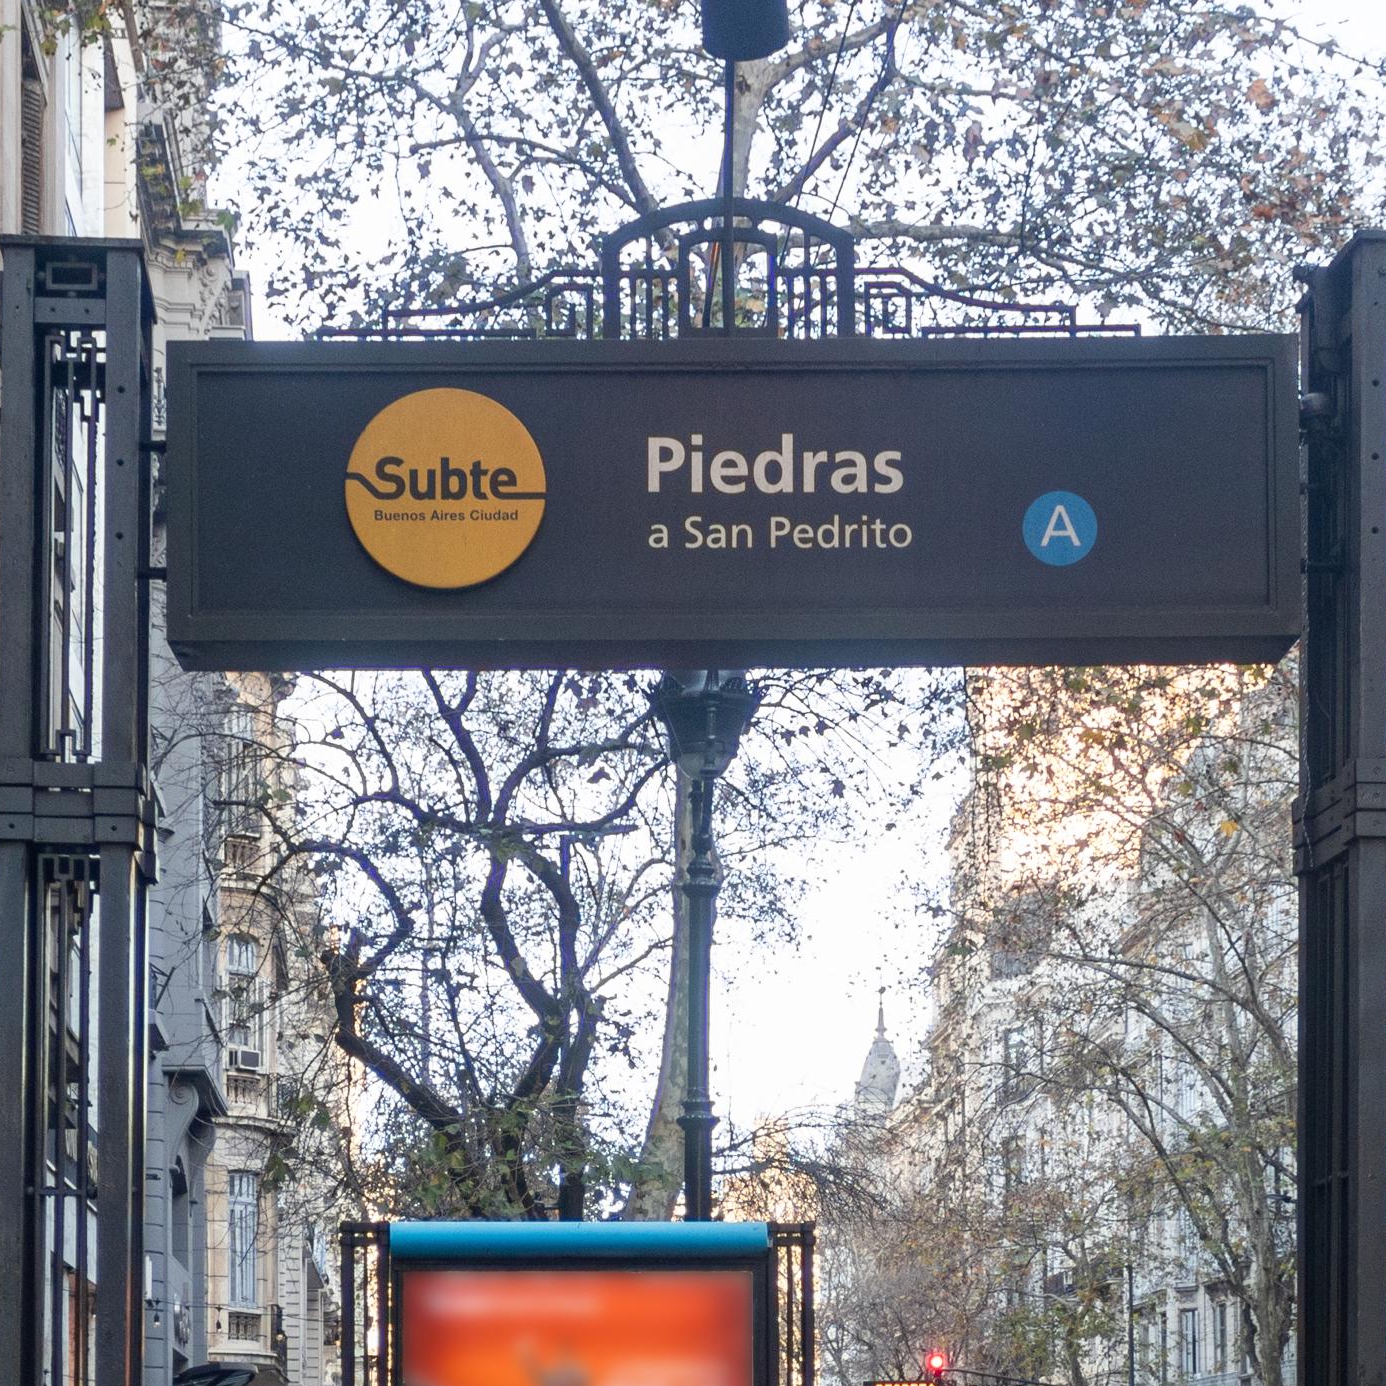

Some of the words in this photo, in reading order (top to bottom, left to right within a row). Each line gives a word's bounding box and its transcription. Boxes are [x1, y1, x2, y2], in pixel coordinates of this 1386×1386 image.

[374, 455, 518, 501] Subte
[647, 432, 905, 494] Piedras
[373, 508, 427, 522] Buenos
[429, 508, 467, 522] Aires
[469, 508, 519, 522] Ciudad
[647, 523, 670, 549] a
[683, 515, 754, 549] San
[769, 513, 913, 549] Pedrito
[1039, 504, 1082, 547] A
